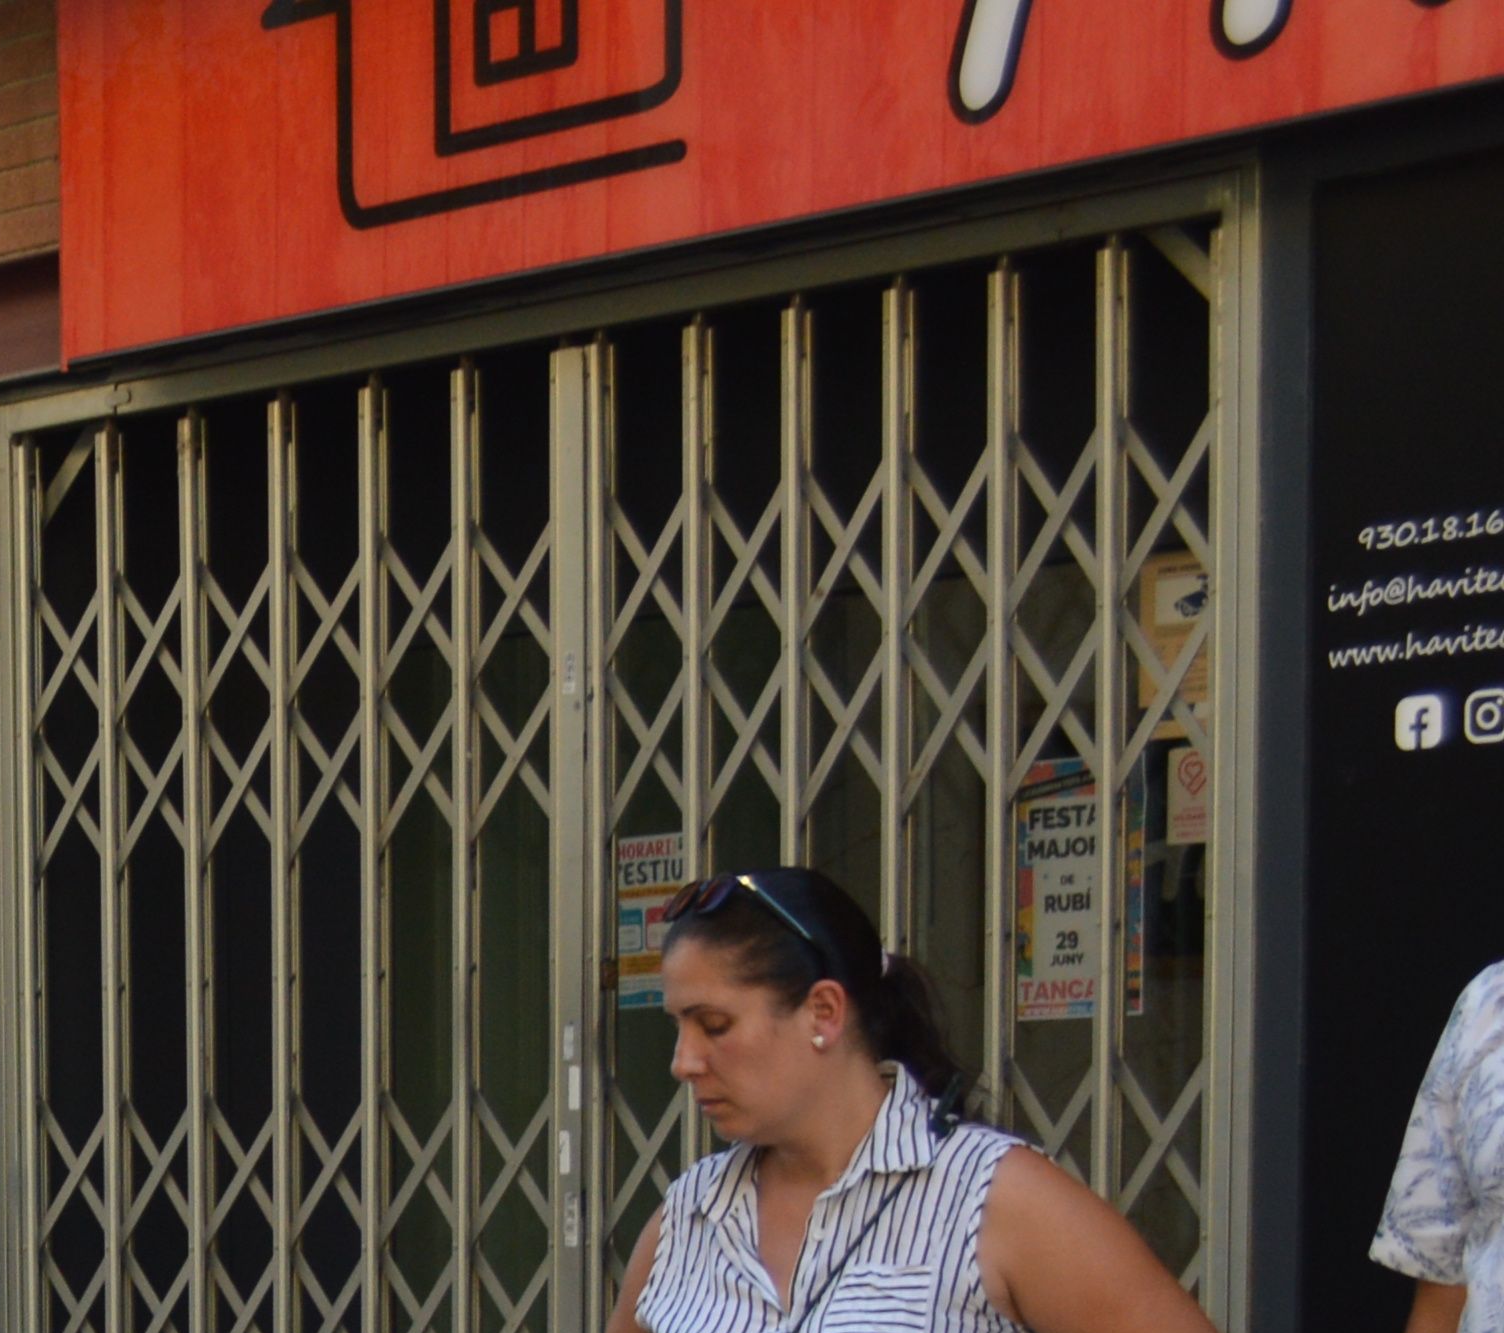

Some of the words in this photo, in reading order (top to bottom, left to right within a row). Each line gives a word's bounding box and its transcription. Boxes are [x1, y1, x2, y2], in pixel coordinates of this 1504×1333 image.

[618, 858, 683, 886] 'ESTIU
[1059, 873, 1075, 887] DE
[1043, 887, 1092, 915] RUBÍ
[1055, 930, 1079, 950] 29
[1050, 953, 1084, 968] JUNY
